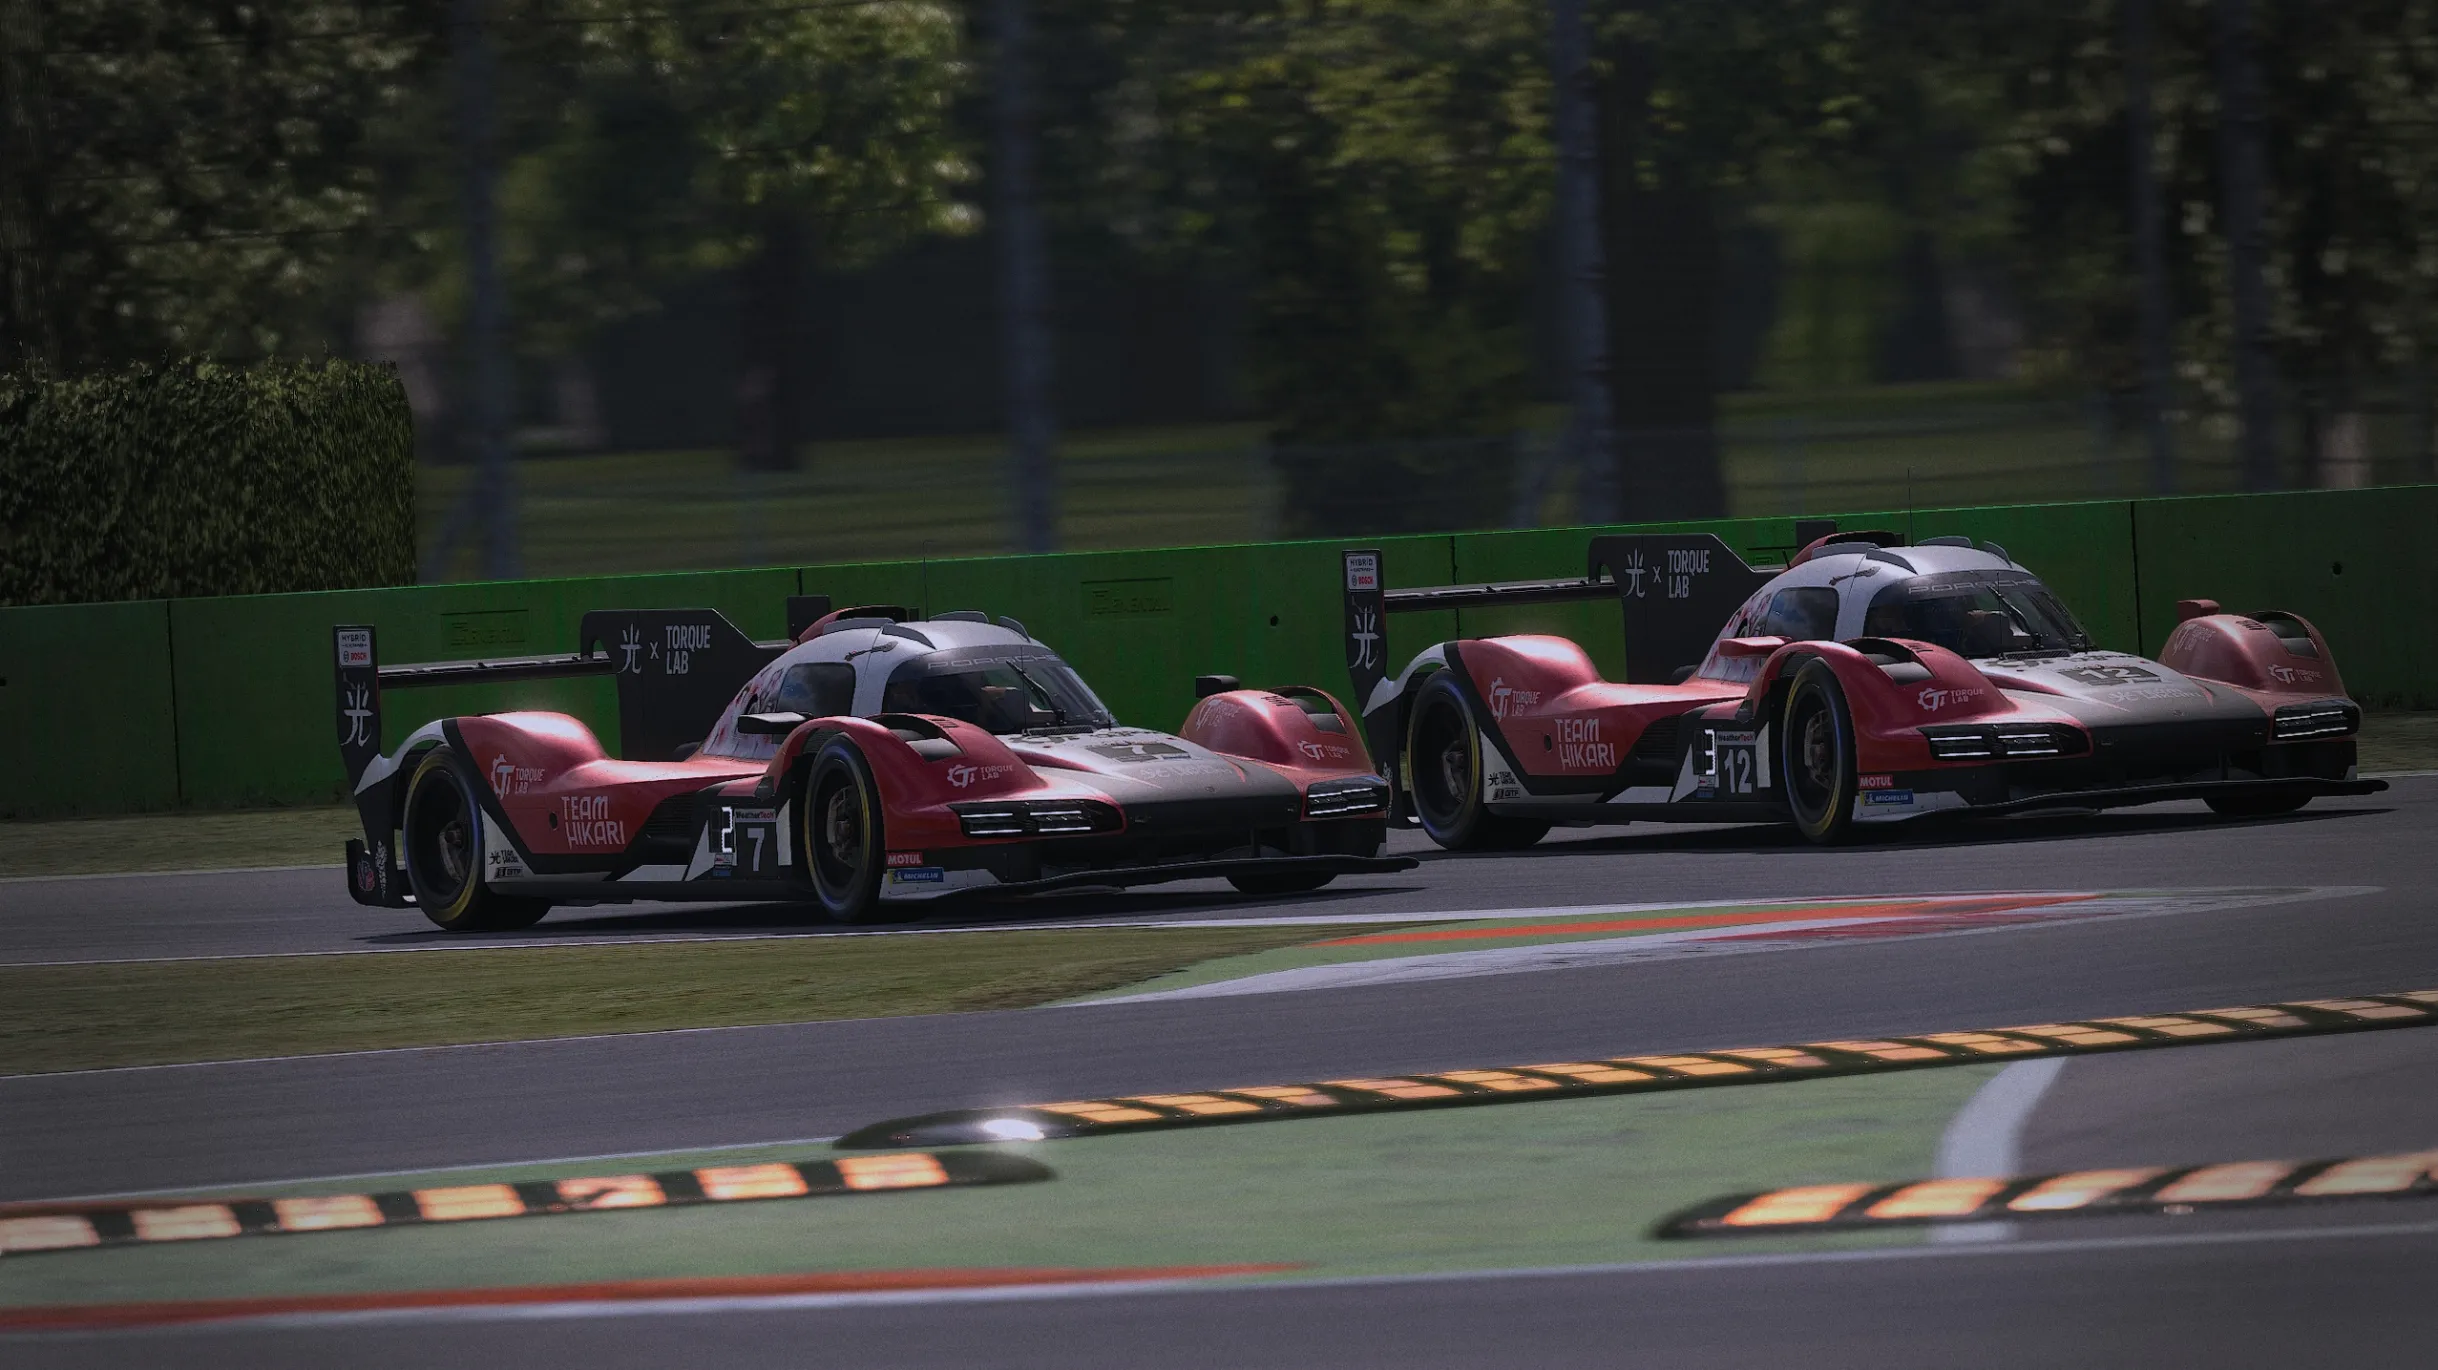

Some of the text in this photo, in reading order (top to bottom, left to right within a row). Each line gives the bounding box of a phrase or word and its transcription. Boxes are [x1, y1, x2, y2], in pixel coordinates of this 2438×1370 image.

[1623, 547, 1647, 598] 光
[1667, 549, 1710, 576] TORQUE
[1668, 575, 1690, 599] LAB
[341, 633, 366, 642] HYBRID
[616, 622, 643, 674] 光
[665, 625, 711, 652] TORQUE
[666, 650, 689, 675] LAB
[1512, 690, 1541, 705] TORQUE
[1950, 688, 1985, 697] TORQUE
[1952, 695, 1969, 704] LAB
[1511, 704, 1525, 717] LAB
[1554, 717, 1600, 742] TEAM
[1558, 742, 1616, 771] HIKARI
[515, 767, 546, 783] TORQUE
[982, 771, 1000, 780] LAB
[1724, 748, 1753, 793] 12
[1859, 776, 1892, 787] MOTUL
[514, 782, 529, 794] LAB
[561, 795, 609, 820] TEAM
[565, 820, 626, 850] HIKARI
[746, 827, 766, 872] 7
[887, 853, 922, 865] MOTUL
[903, 871, 939, 880] MICHELIN
